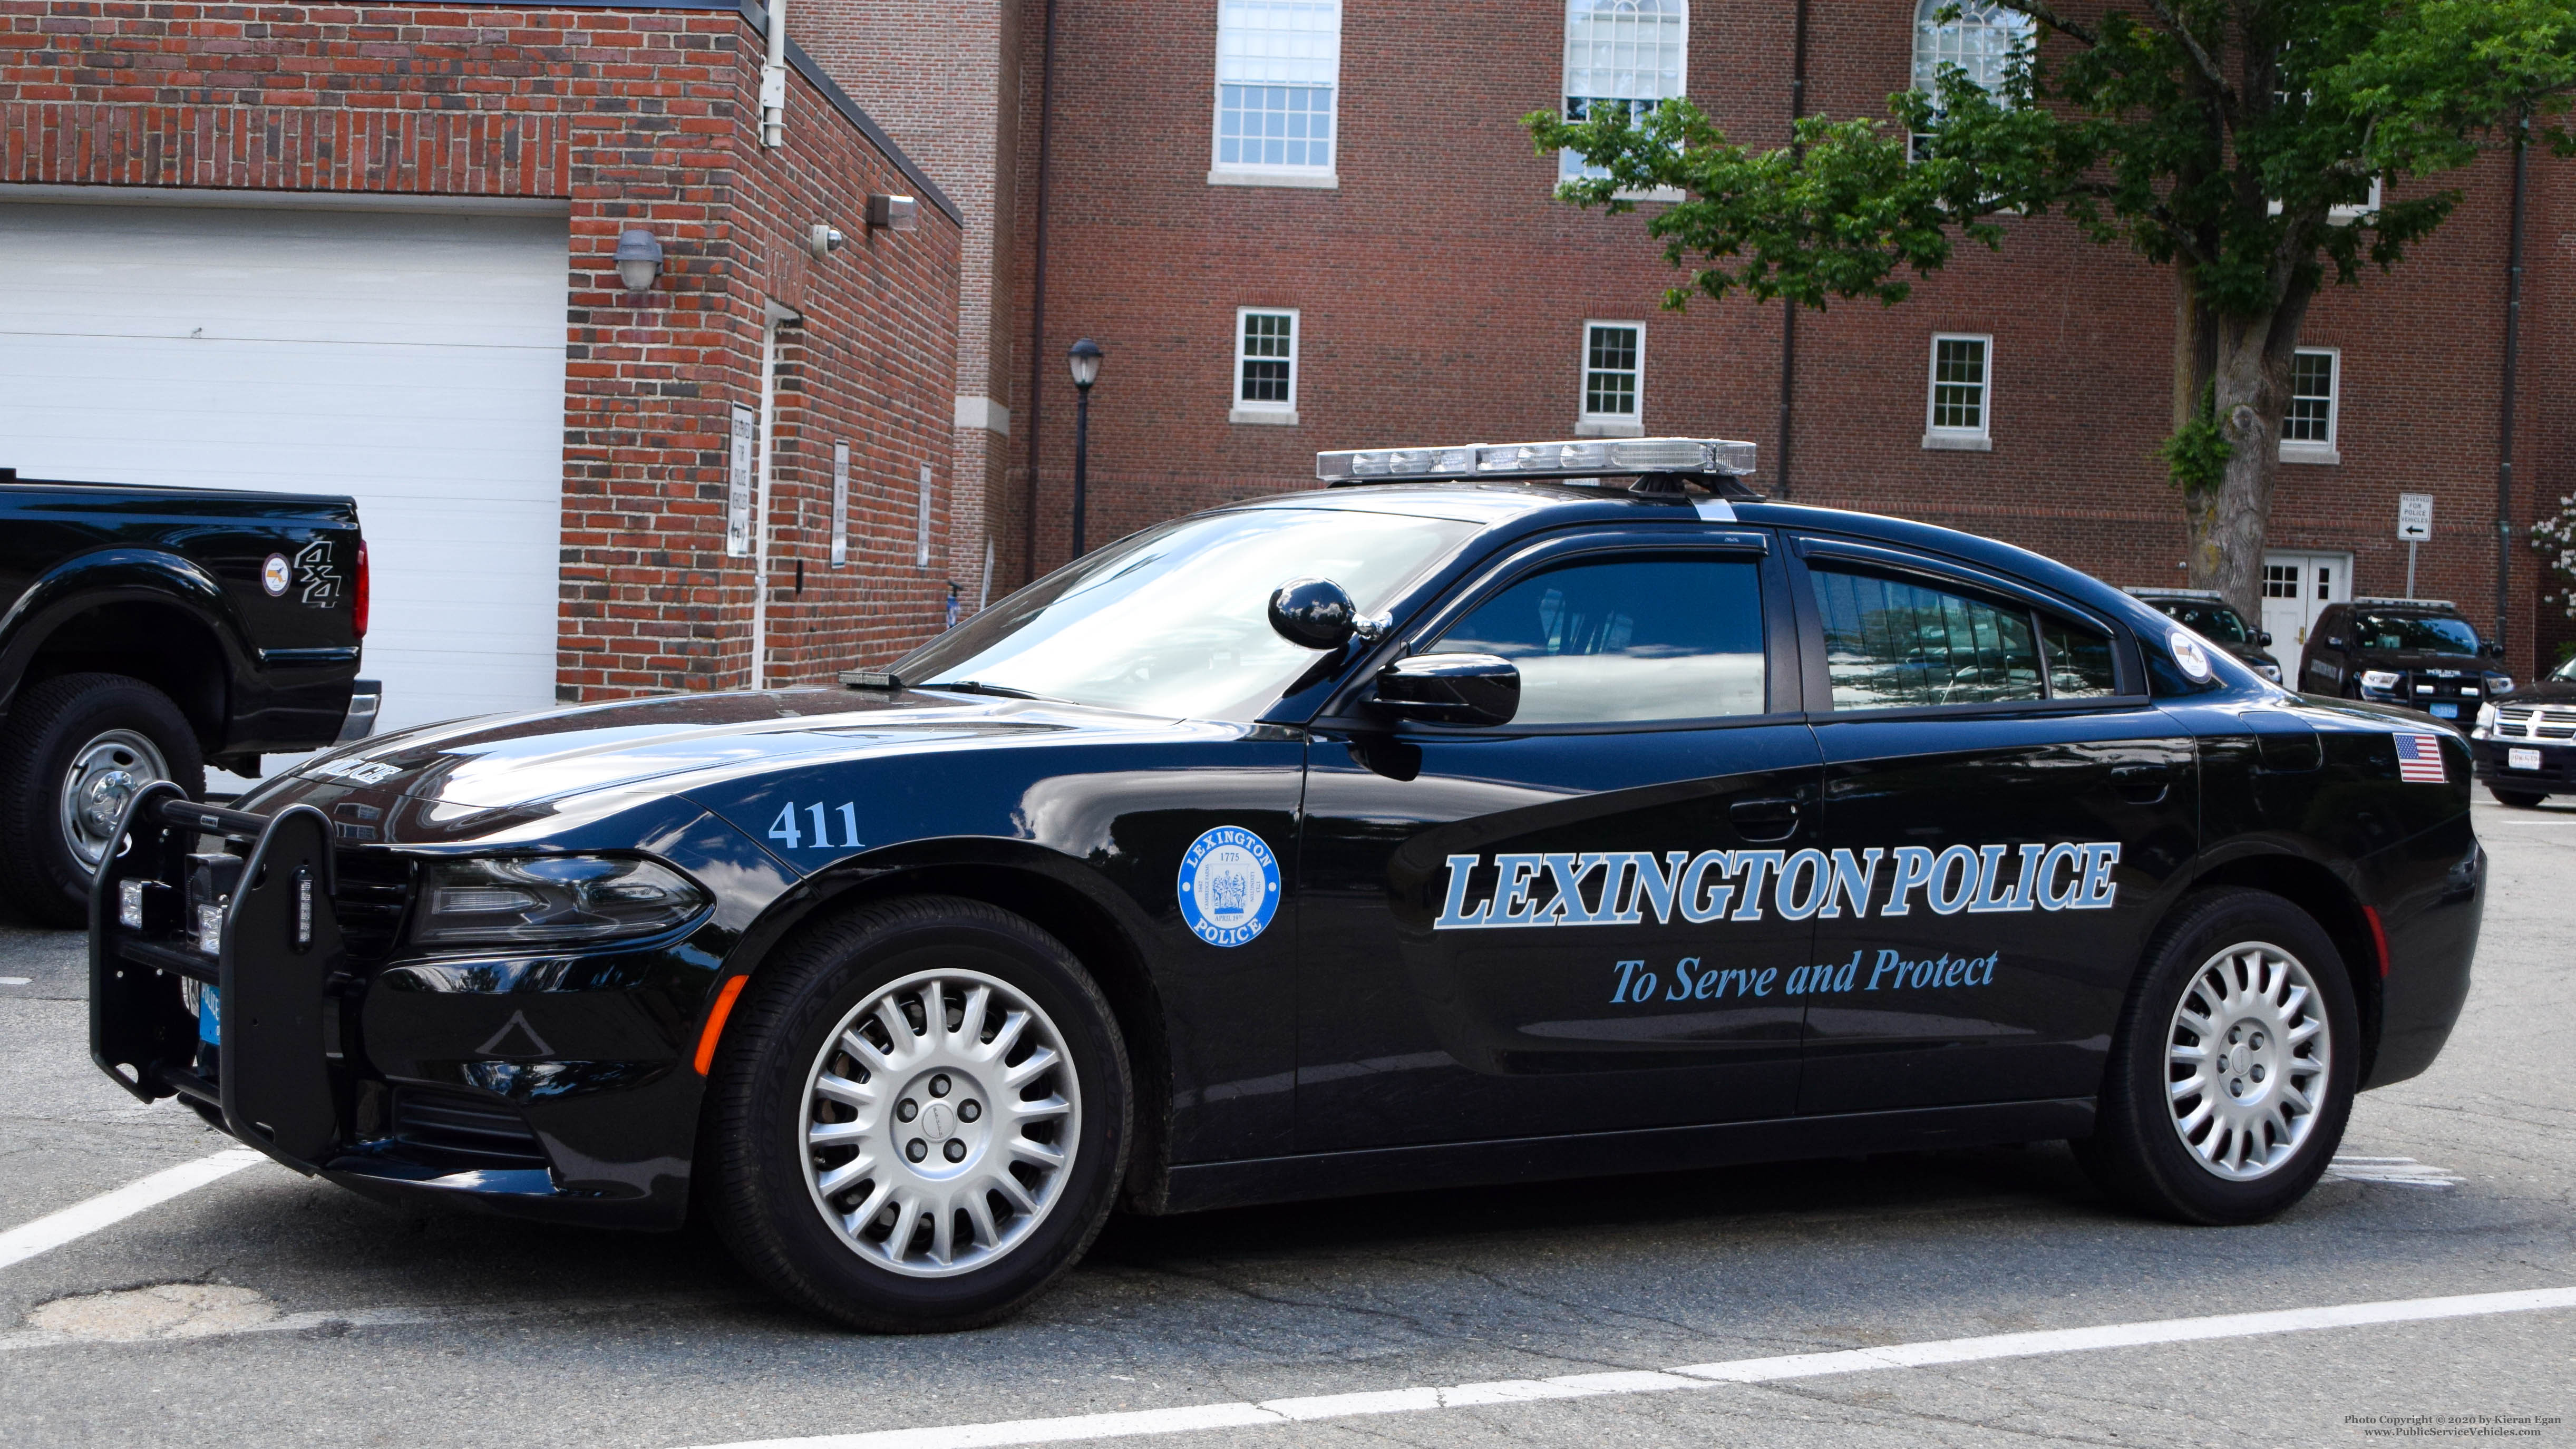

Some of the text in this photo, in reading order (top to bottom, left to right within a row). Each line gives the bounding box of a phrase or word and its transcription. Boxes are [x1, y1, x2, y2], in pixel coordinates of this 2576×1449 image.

[768, 801, 866, 849] 411
[1186, 830, 1272, 869] LEXINGTON
[1220, 852, 1240, 862] 1775
[1433, 841, 2121, 930] LEXINGTON POLICE
[1193, 917, 1262, 944] POLICE
[1609, 949, 1998, 1004] To Serve and Protect
[202, 982, 220, 1021] POLICE
